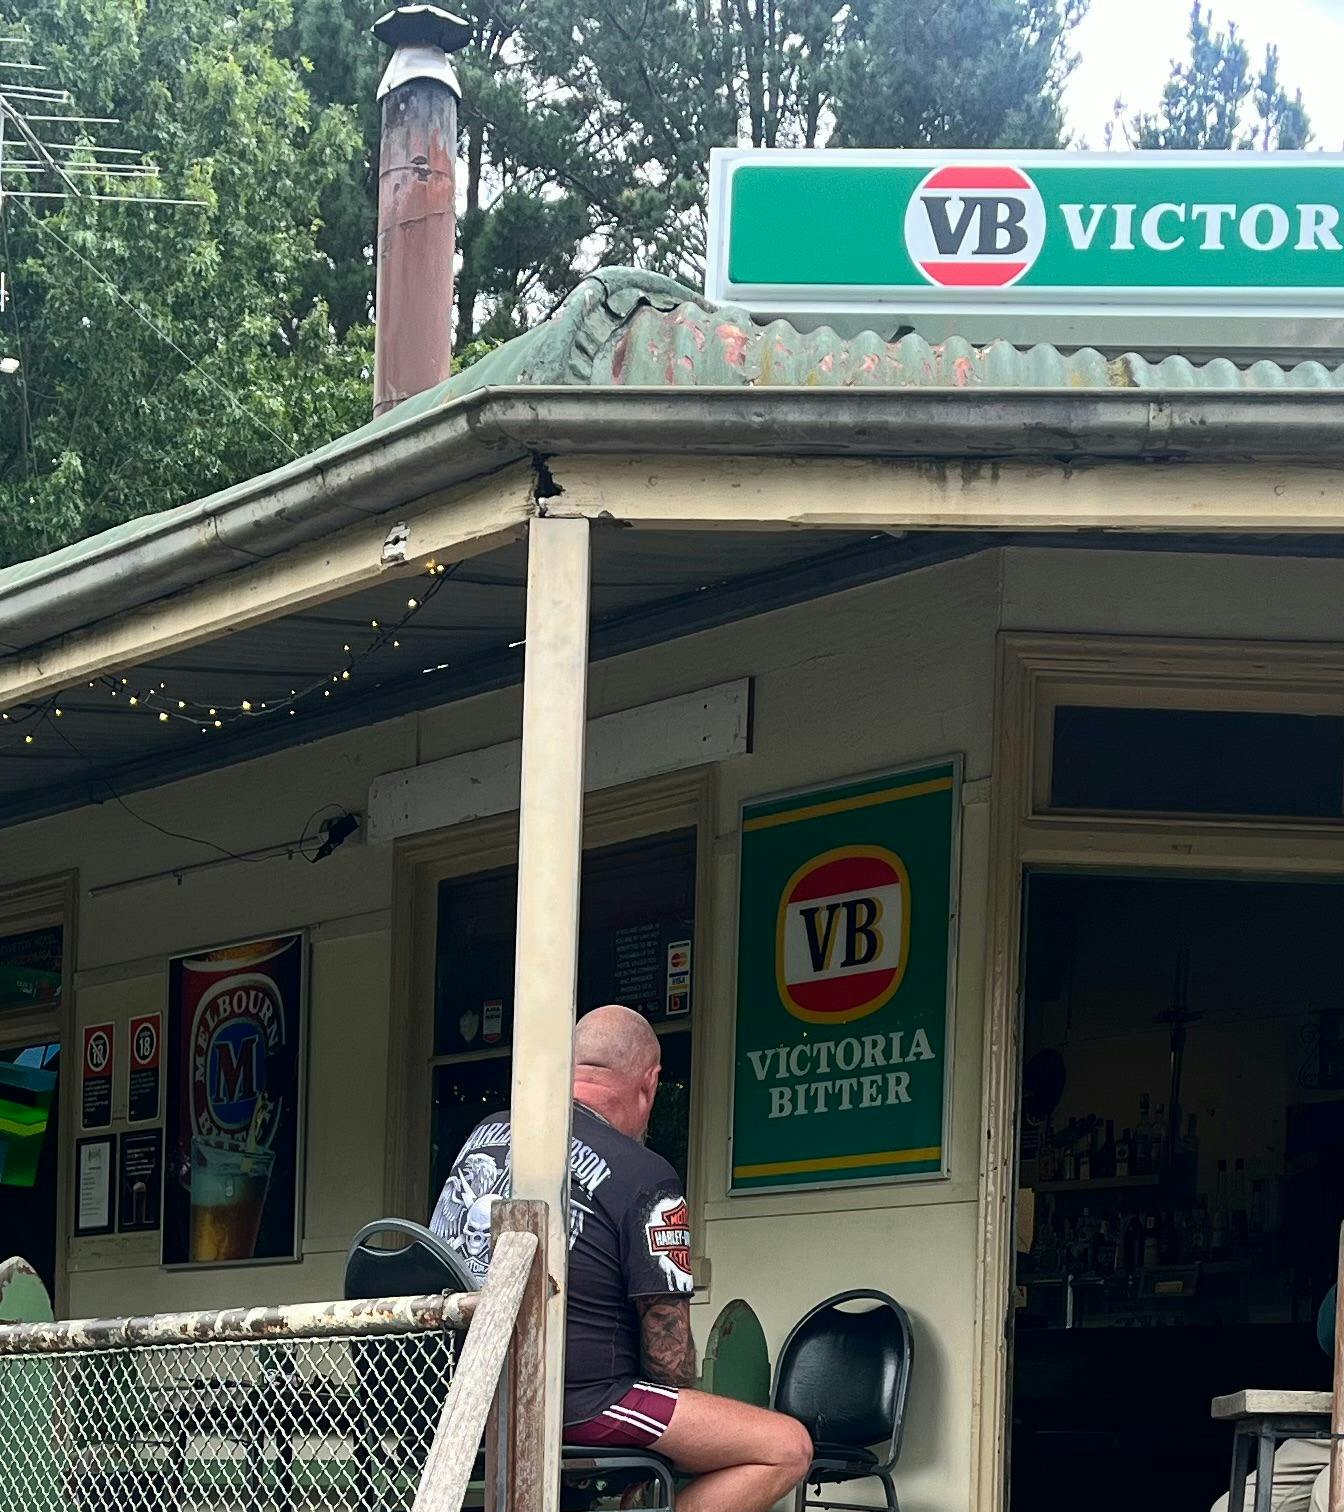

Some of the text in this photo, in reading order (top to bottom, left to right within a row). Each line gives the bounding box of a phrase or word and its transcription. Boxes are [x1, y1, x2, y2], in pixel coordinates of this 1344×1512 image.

[920, 197, 1028, 255] VB
[800, 896, 884, 972] VB
[138, 1036, 151, 1057] 18
[194, 988, 281, 1084] MELBOURN
[747, 1028, 935, 1081] VICTORIA
[213, 1034, 260, 1105] M
[768, 1071, 912, 1119] BITTER
